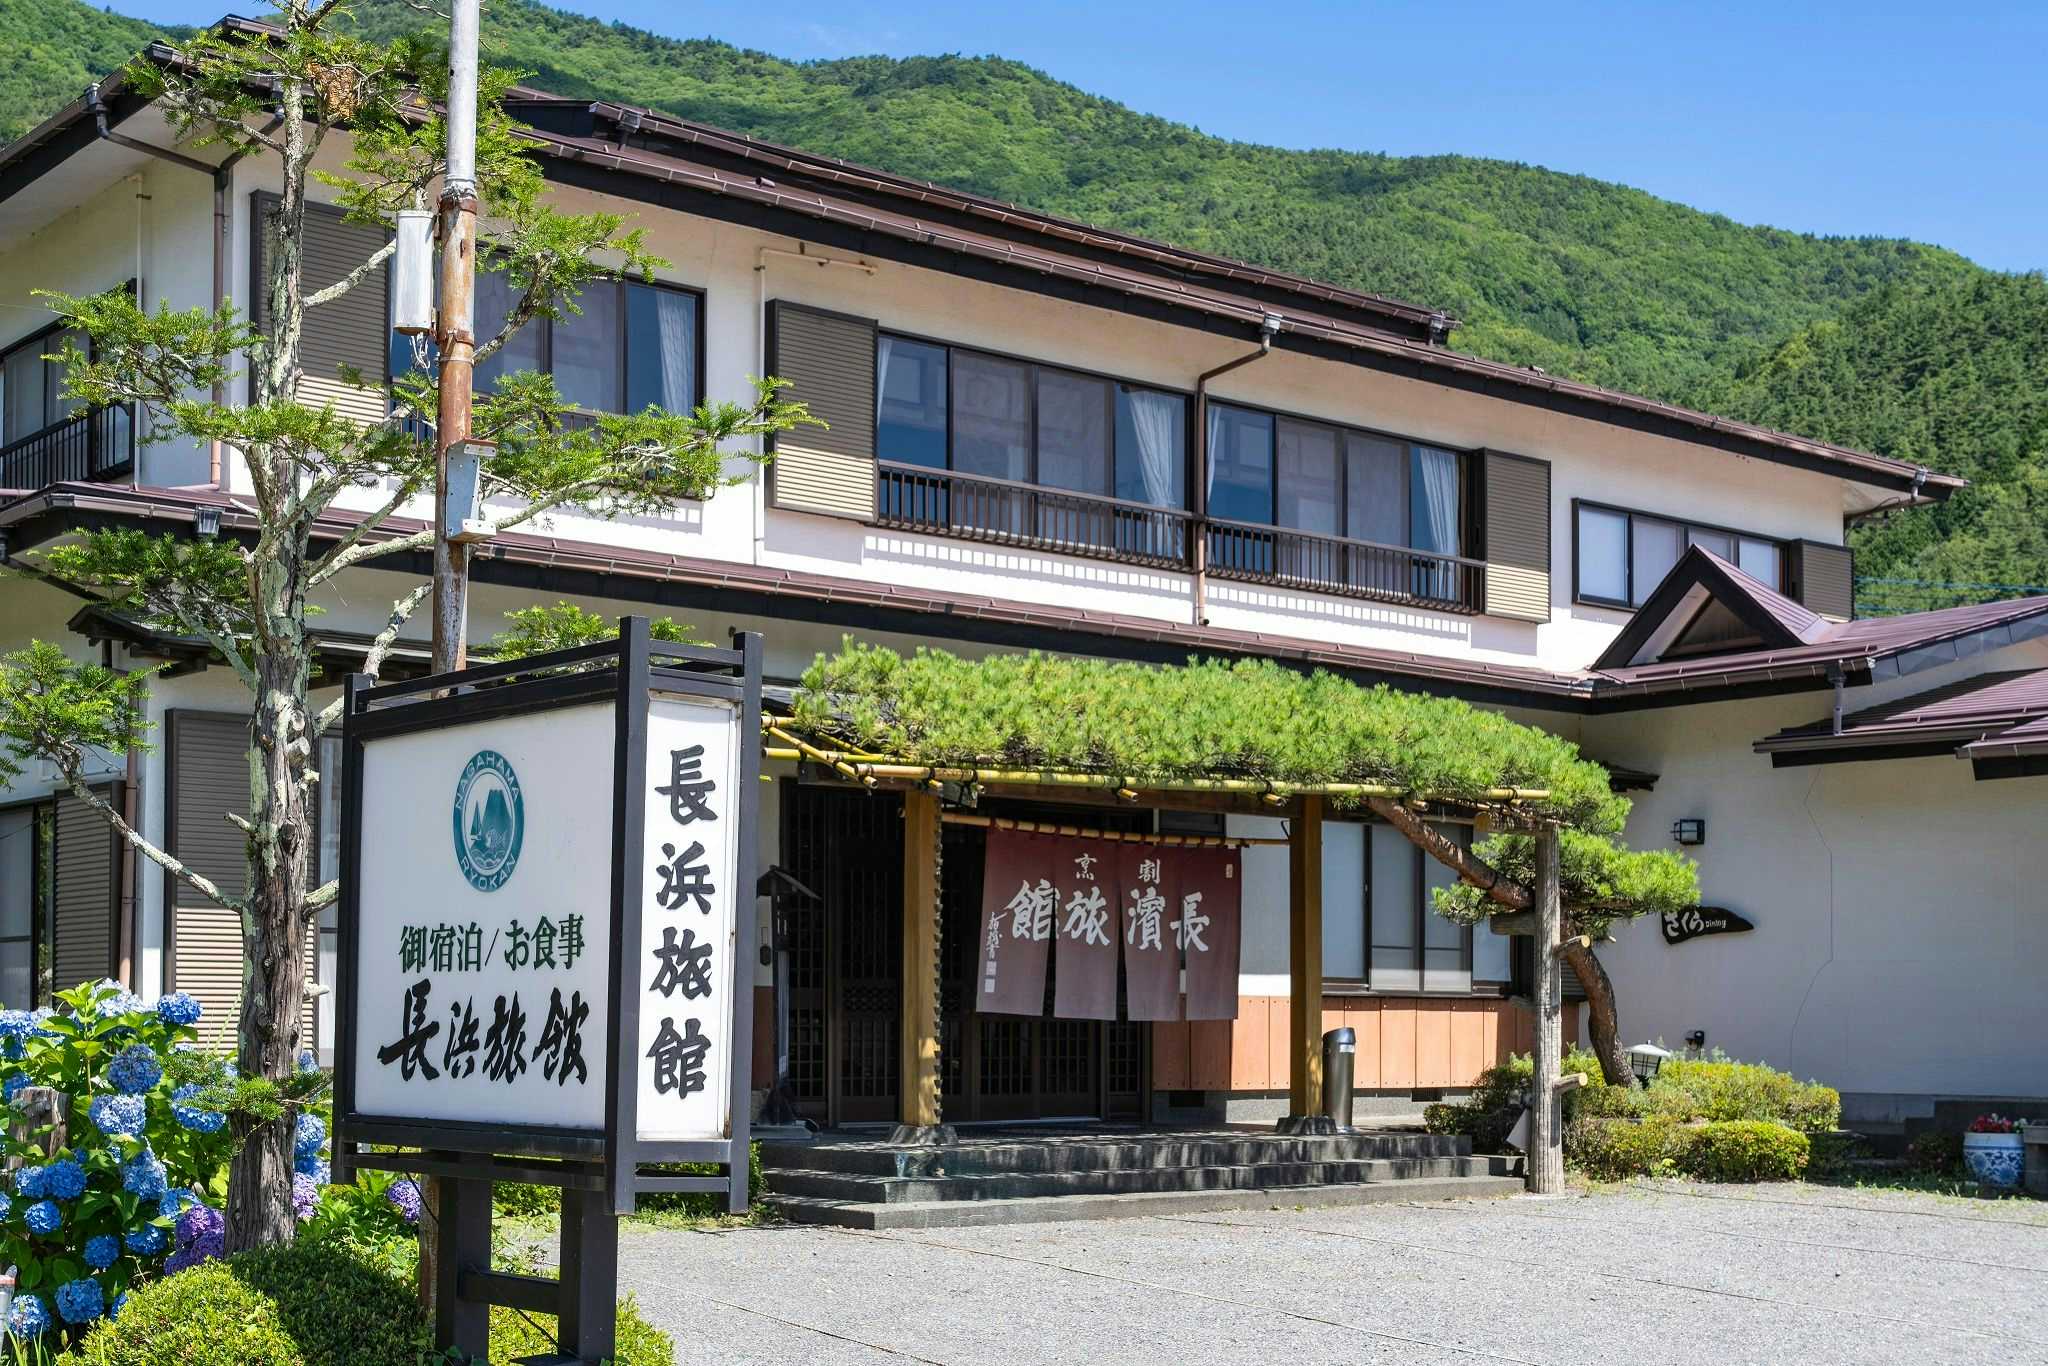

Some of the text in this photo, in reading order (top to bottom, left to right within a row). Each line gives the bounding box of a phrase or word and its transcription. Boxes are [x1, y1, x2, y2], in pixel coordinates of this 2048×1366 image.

[455, 752, 520, 809] NAGAHAMA
[460, 854, 517, 891] RYOKAN
[646, 744, 718, 1100] 長浜旅館
[1664, 911, 1705, 937] さくら
[376, 978, 590, 1087] 長浜旅館
